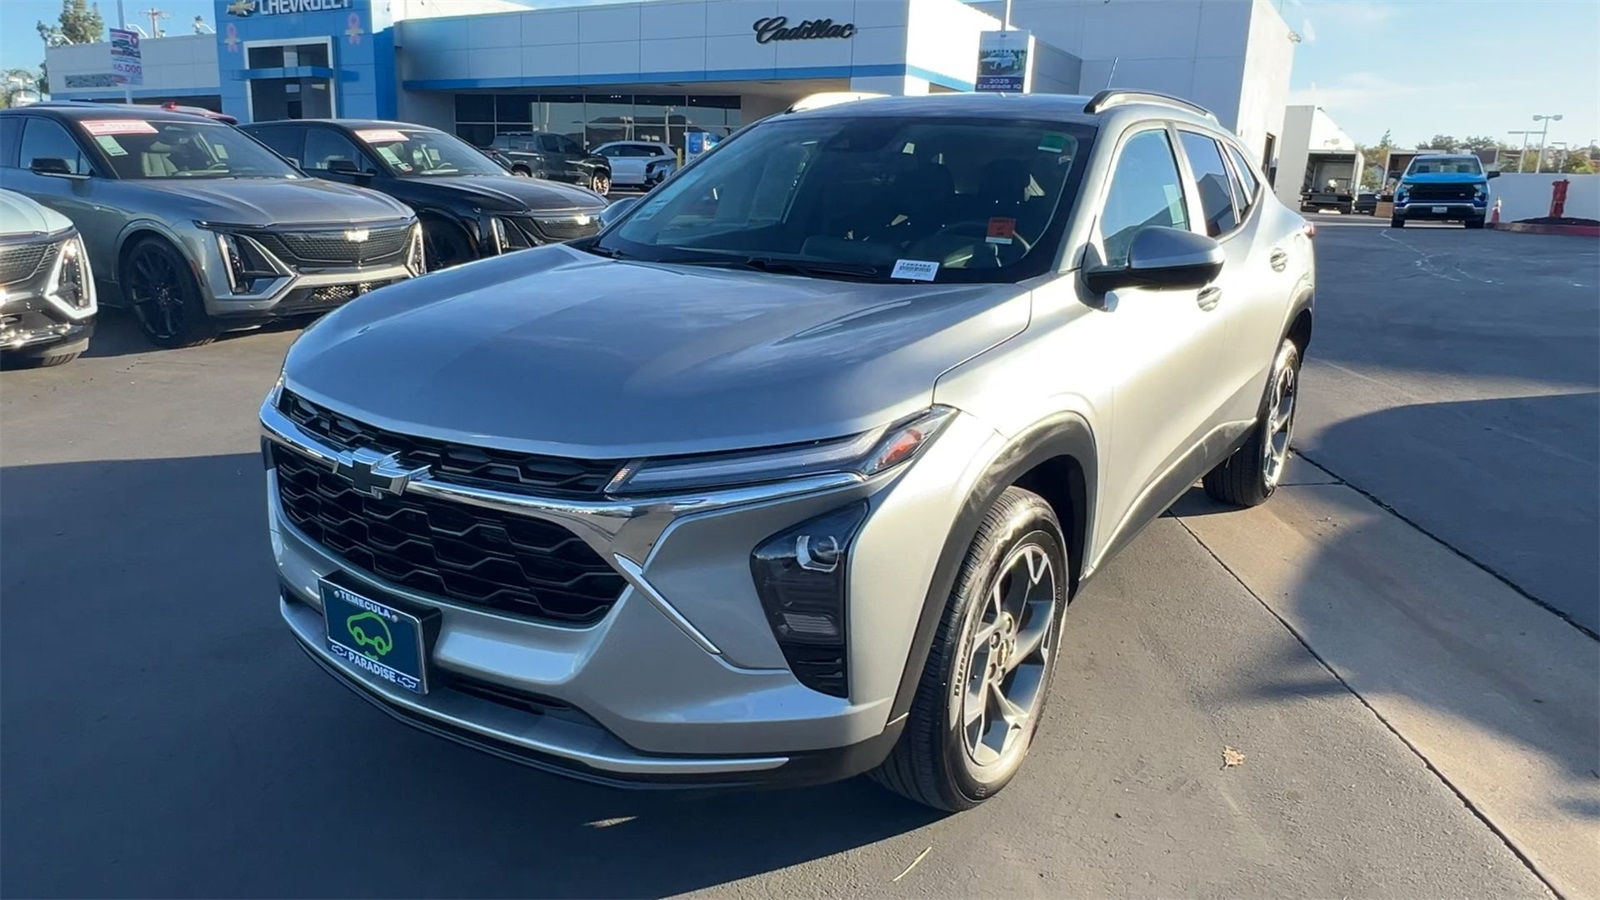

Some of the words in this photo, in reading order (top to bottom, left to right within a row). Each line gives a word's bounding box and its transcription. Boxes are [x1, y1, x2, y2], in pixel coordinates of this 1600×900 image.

[753, 16, 854, 44] Cadillac
[339, 589, 391, 619] TEMECULA
[348, 651, 396, 682] PARADISE
